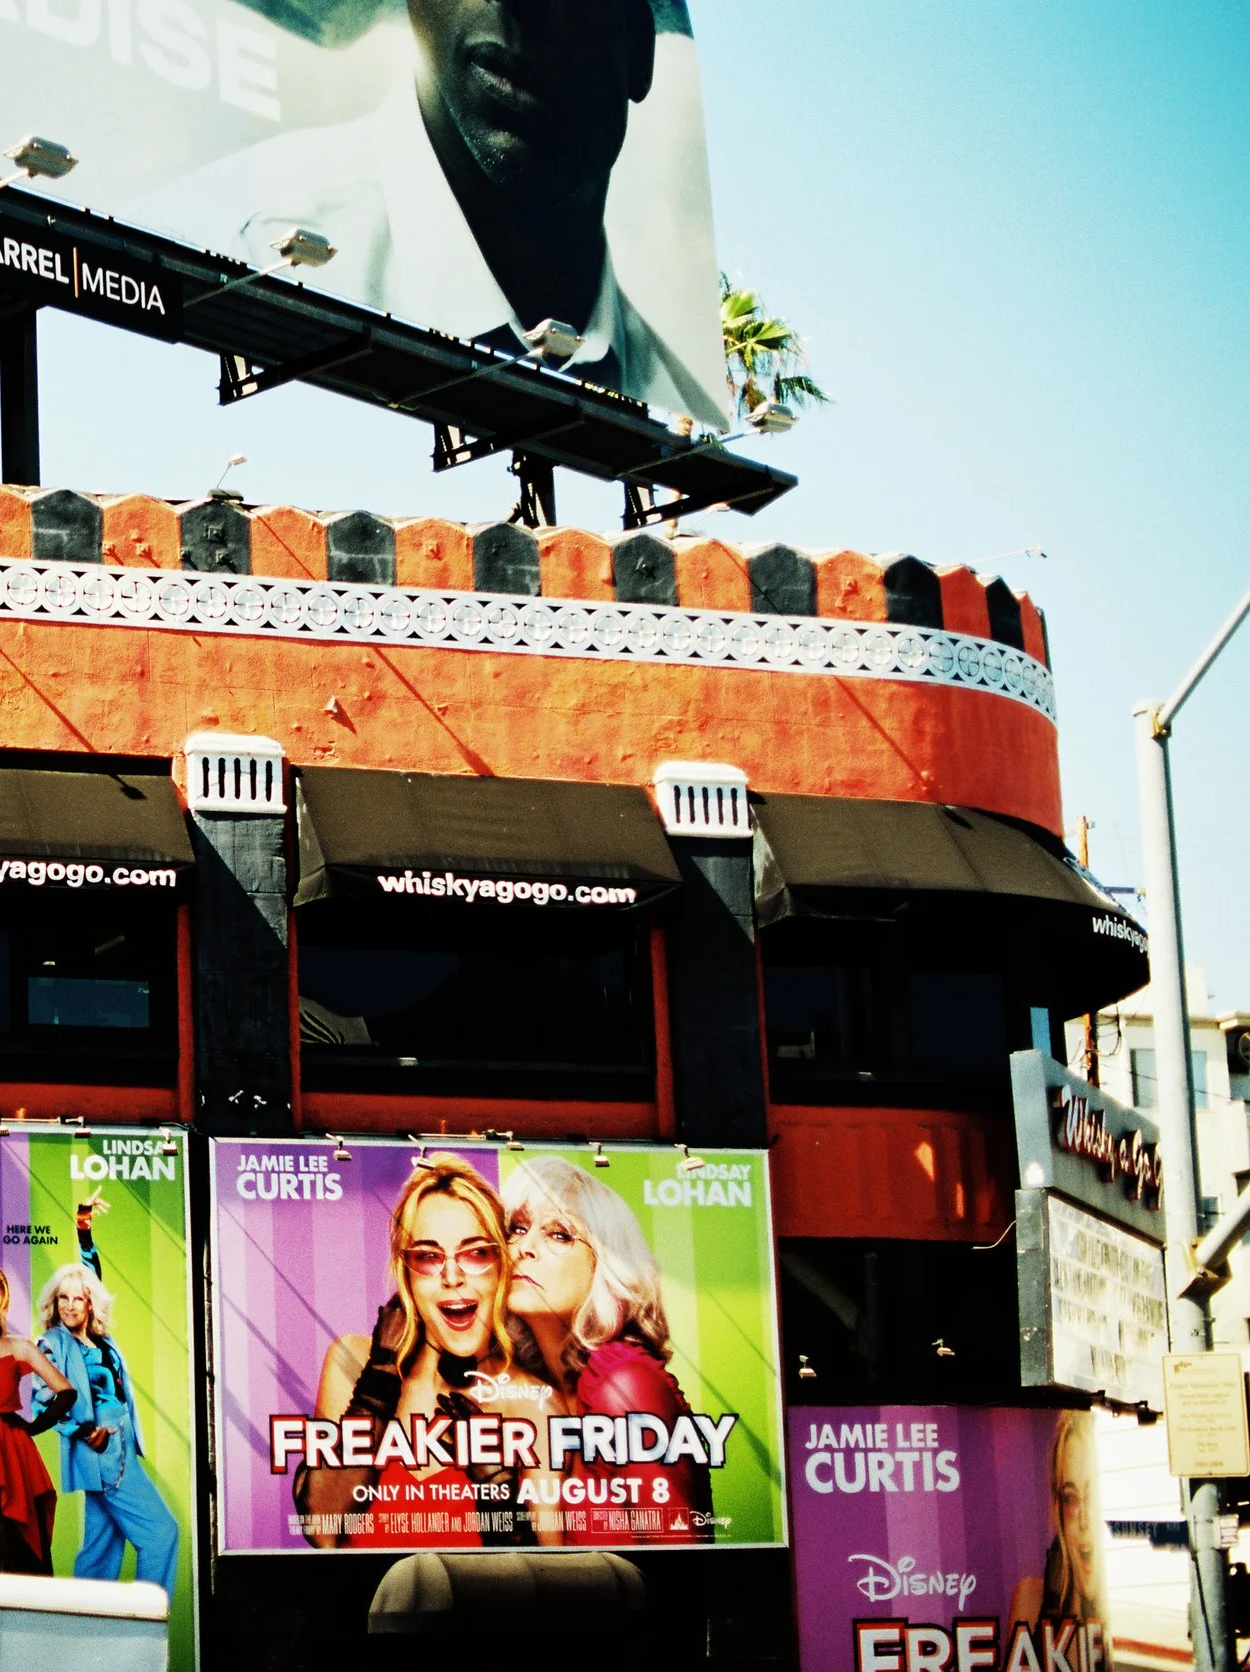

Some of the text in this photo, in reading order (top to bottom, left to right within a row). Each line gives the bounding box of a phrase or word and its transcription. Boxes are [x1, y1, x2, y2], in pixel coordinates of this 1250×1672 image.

[82, 262, 166, 315] MEDIA
[377, 870, 637, 905] whiskyagogo.com
[103, 1139, 168, 1155] LINDSA
[70, 1155, 176, 1180] LOHAN
[237, 1154, 328, 1172] JAMIE LEE
[236, 1172, 343, 1200] CURTIS
[643, 1179, 752, 1207] LOHAN
[3, 1235, 58, 1245] GO AGAIN
[6, 1225, 51, 1235] HERE WE
[269, 1411, 739, 1475] FREAKIER FRIDAY
[805, 1423, 939, 1450] JAMIE LEE
[805, 1450, 961, 1494] CURTIS
[352, 1477, 670, 1504] ONLY IN THEATERS AUGUST 8
[322, 1513, 342, 1534] MARY
[390, 1513, 410, 1533] ELYSE
[463, 1512, 490, 1532] JORDAN
[491, 1512, 514, 1532] WEISS
[565, 1510, 587, 1531] WEISS
